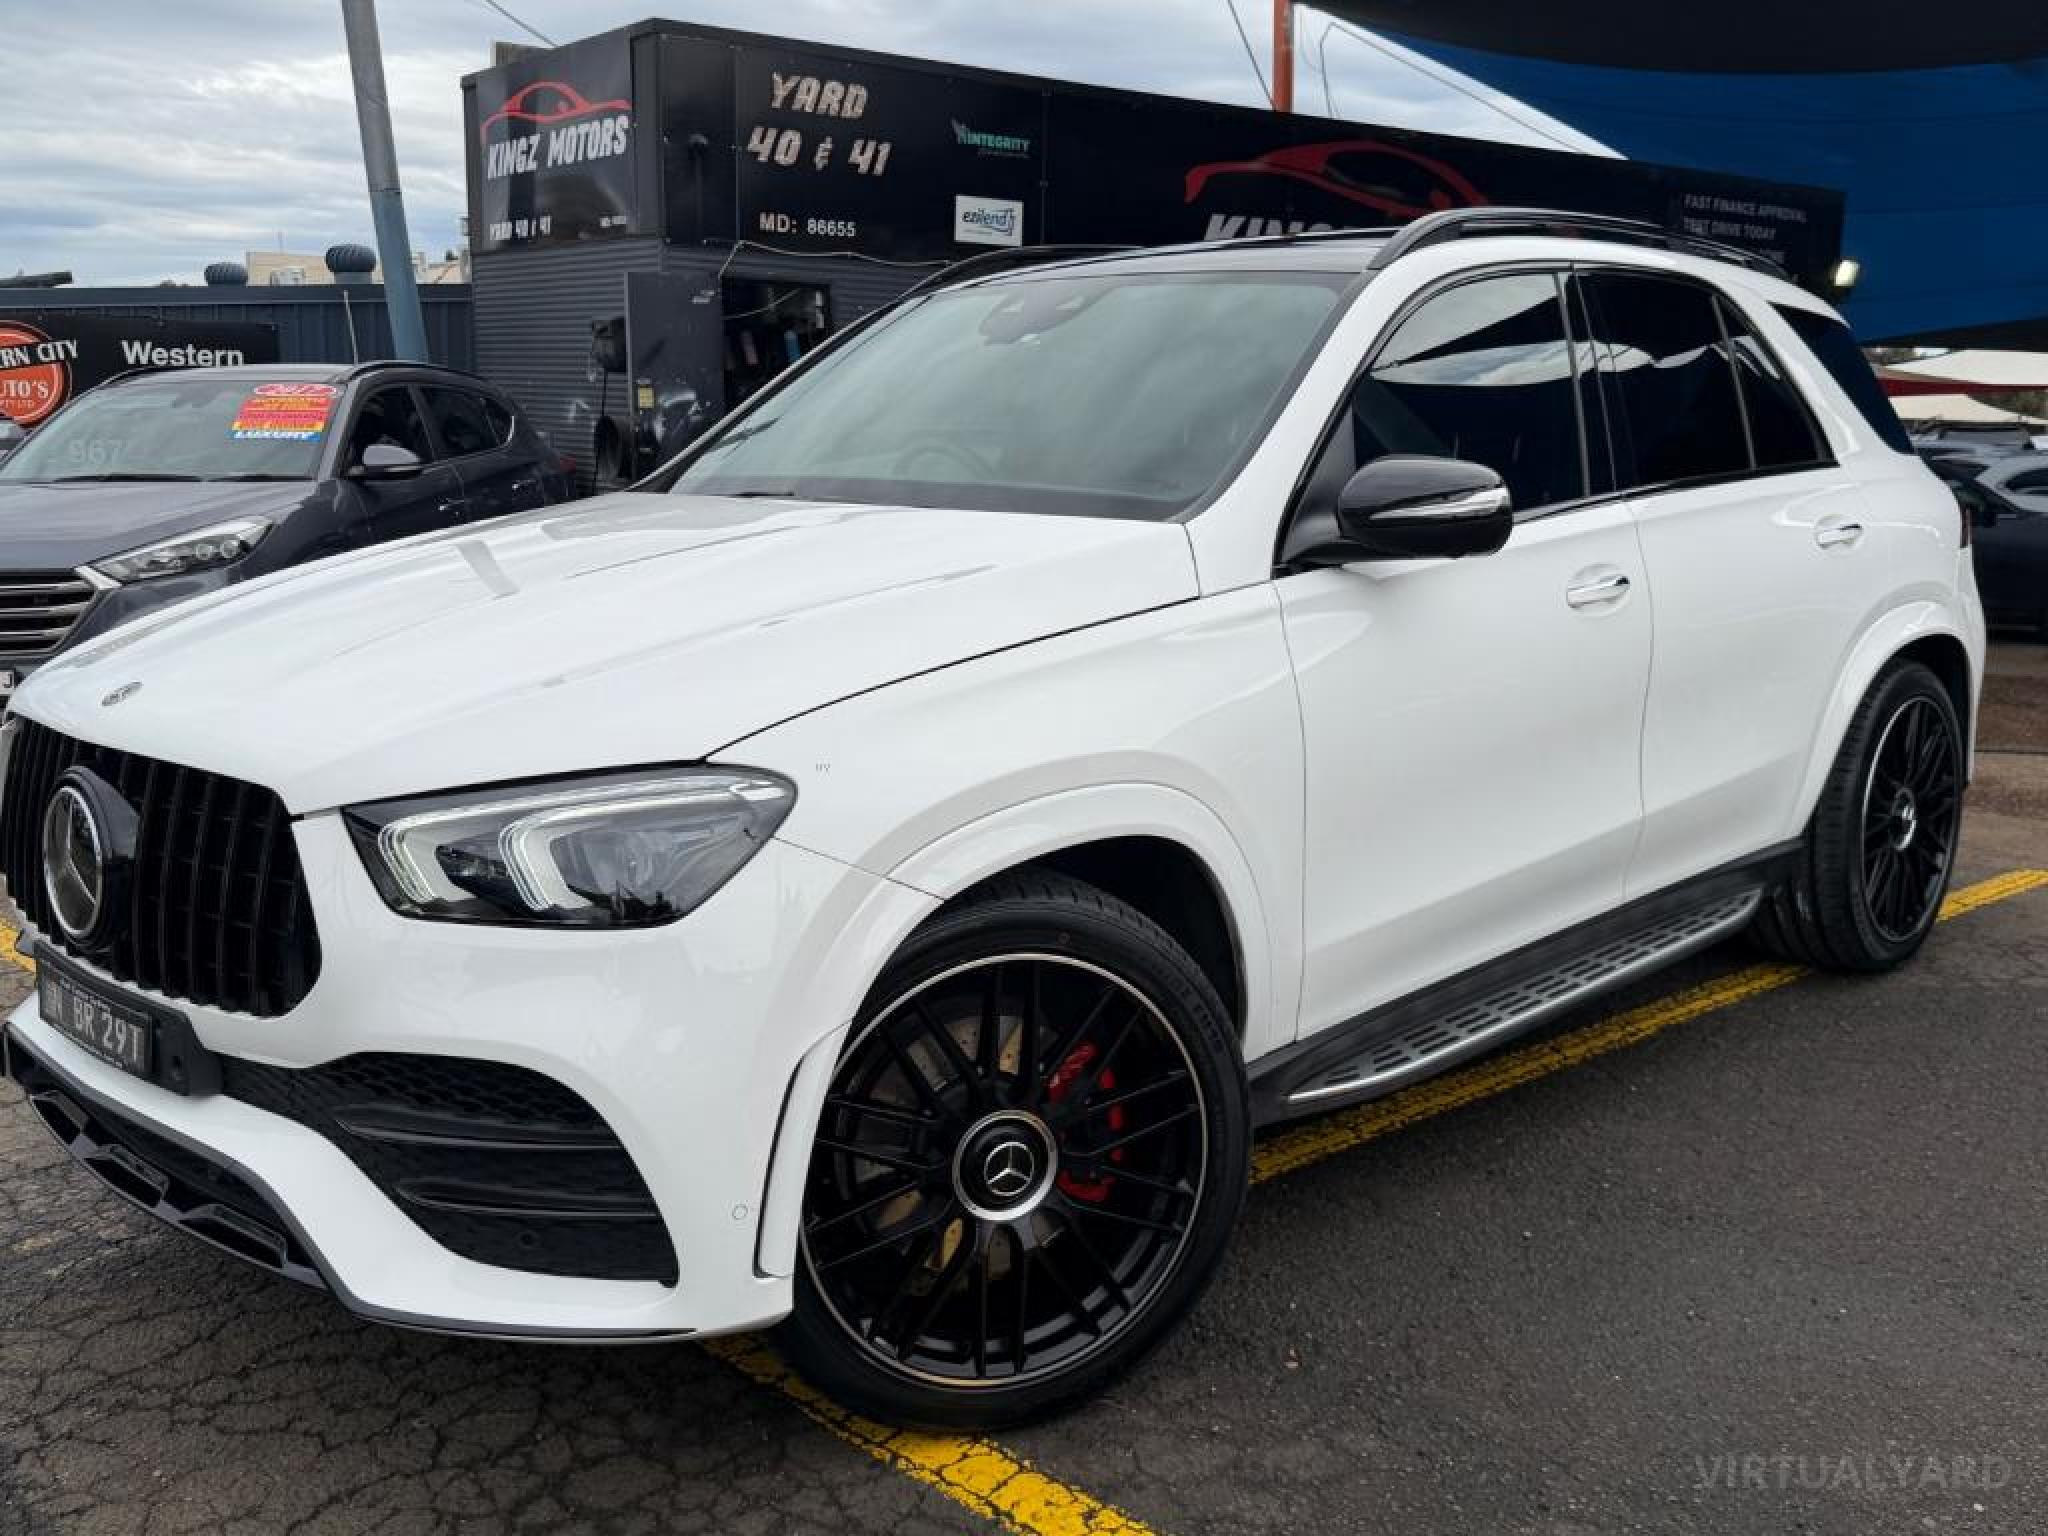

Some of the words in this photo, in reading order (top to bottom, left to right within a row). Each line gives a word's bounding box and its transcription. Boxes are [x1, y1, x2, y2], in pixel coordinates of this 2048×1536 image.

[771, 71, 868, 119] YARD
[488, 133, 541, 180] KINGZ
[547, 115, 629, 168] MOTORS
[748, 126, 801, 166] 40
[849, 139, 893, 175] 41
[967, 132, 1031, 152] INTEGRITY
[759, 211, 798, 234] MD:
[807, 218, 857, 237] 86655
[37, 339, 78, 361] CITY
[121, 339, 244, 367] Western
